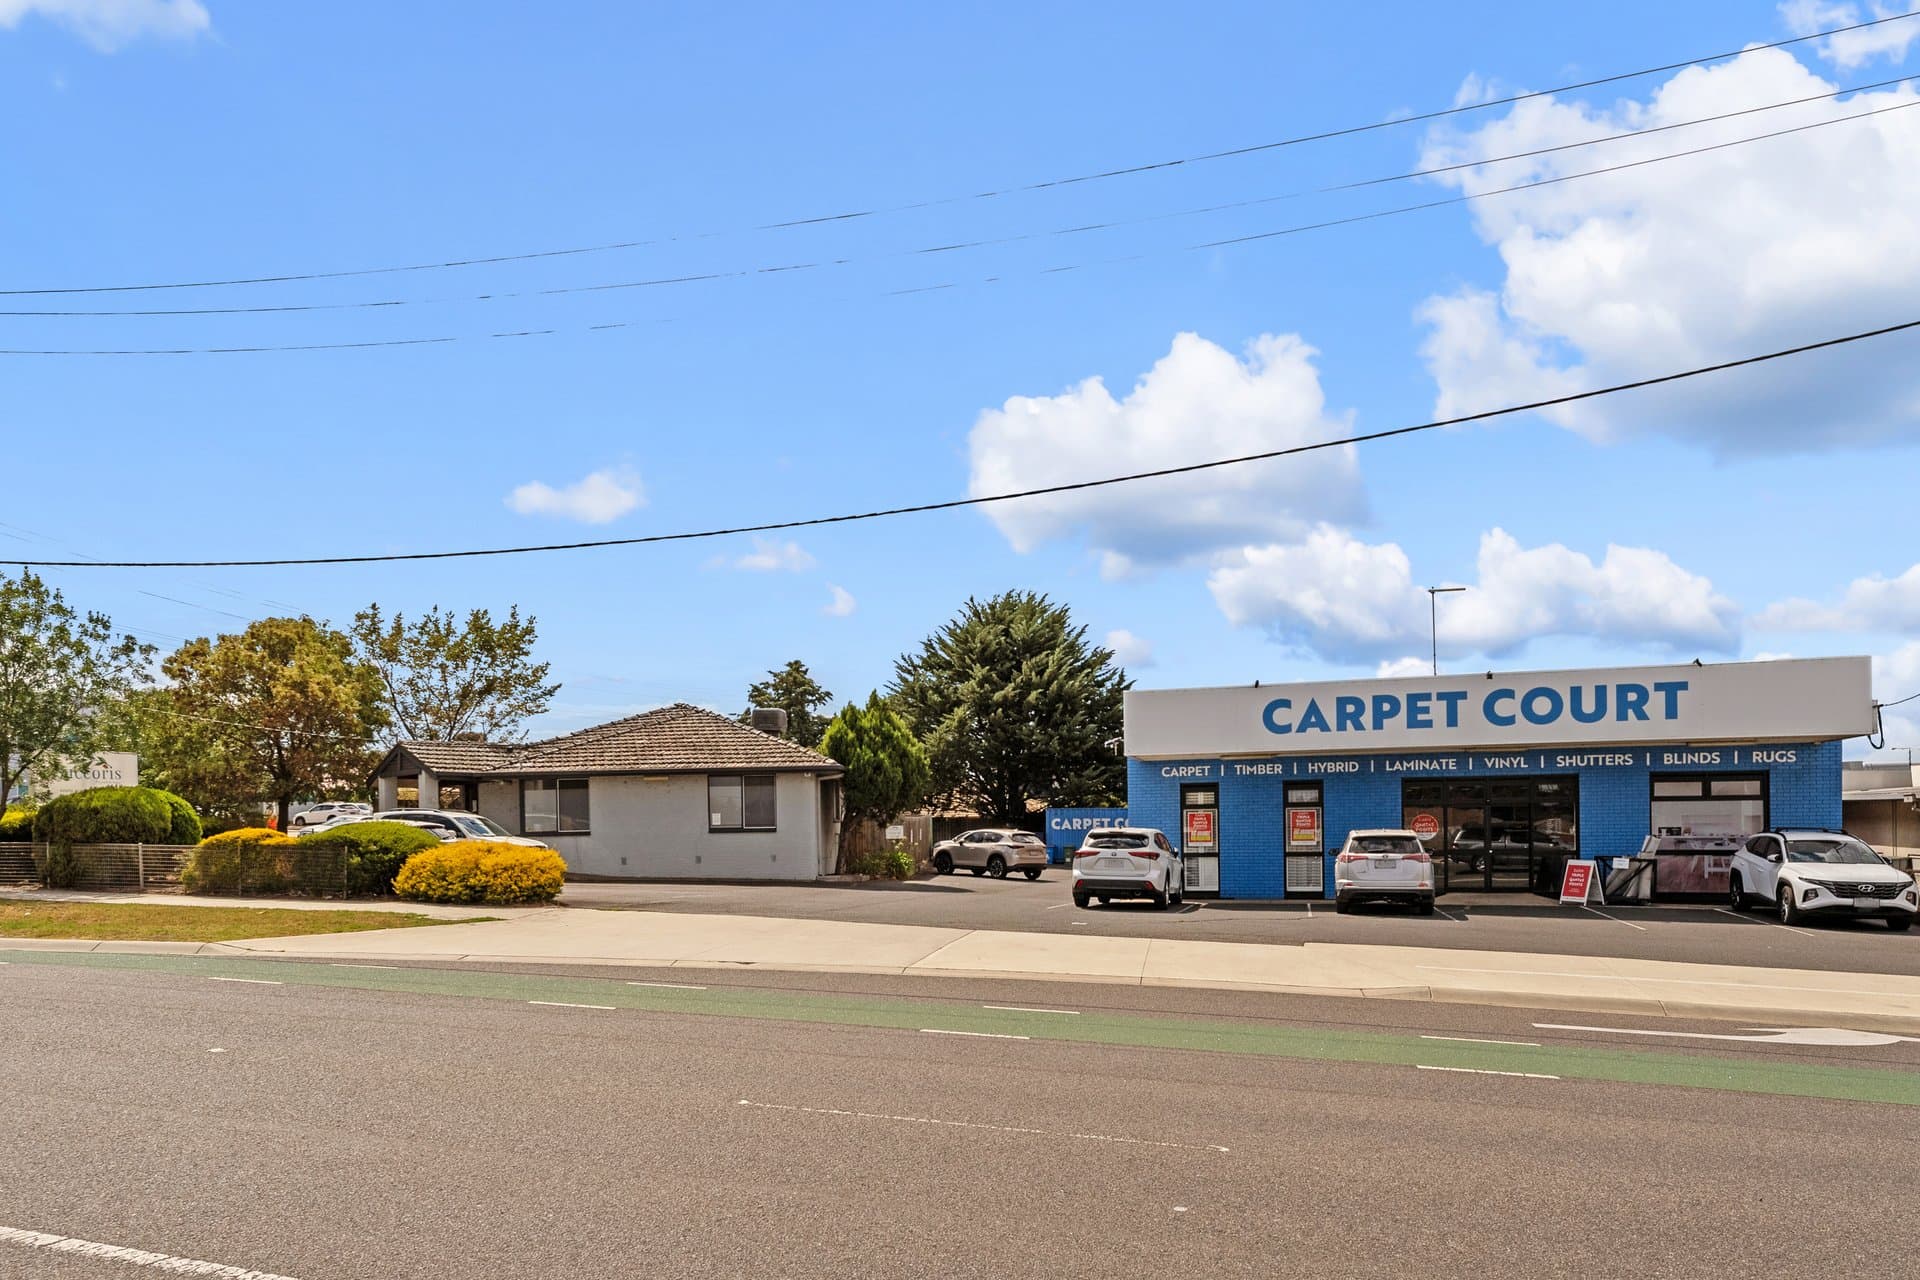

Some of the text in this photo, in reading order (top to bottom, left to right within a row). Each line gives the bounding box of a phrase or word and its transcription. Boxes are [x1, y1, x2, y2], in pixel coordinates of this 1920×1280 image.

[1263, 681, 1689, 735] CARPET COURT
[1161, 750, 1797, 778] CARPET TIMBER HYBRID LAMINATE VINYL SHUTTERS BLINDS RUGS
[1051, 817, 1128, 830] CARPET C
